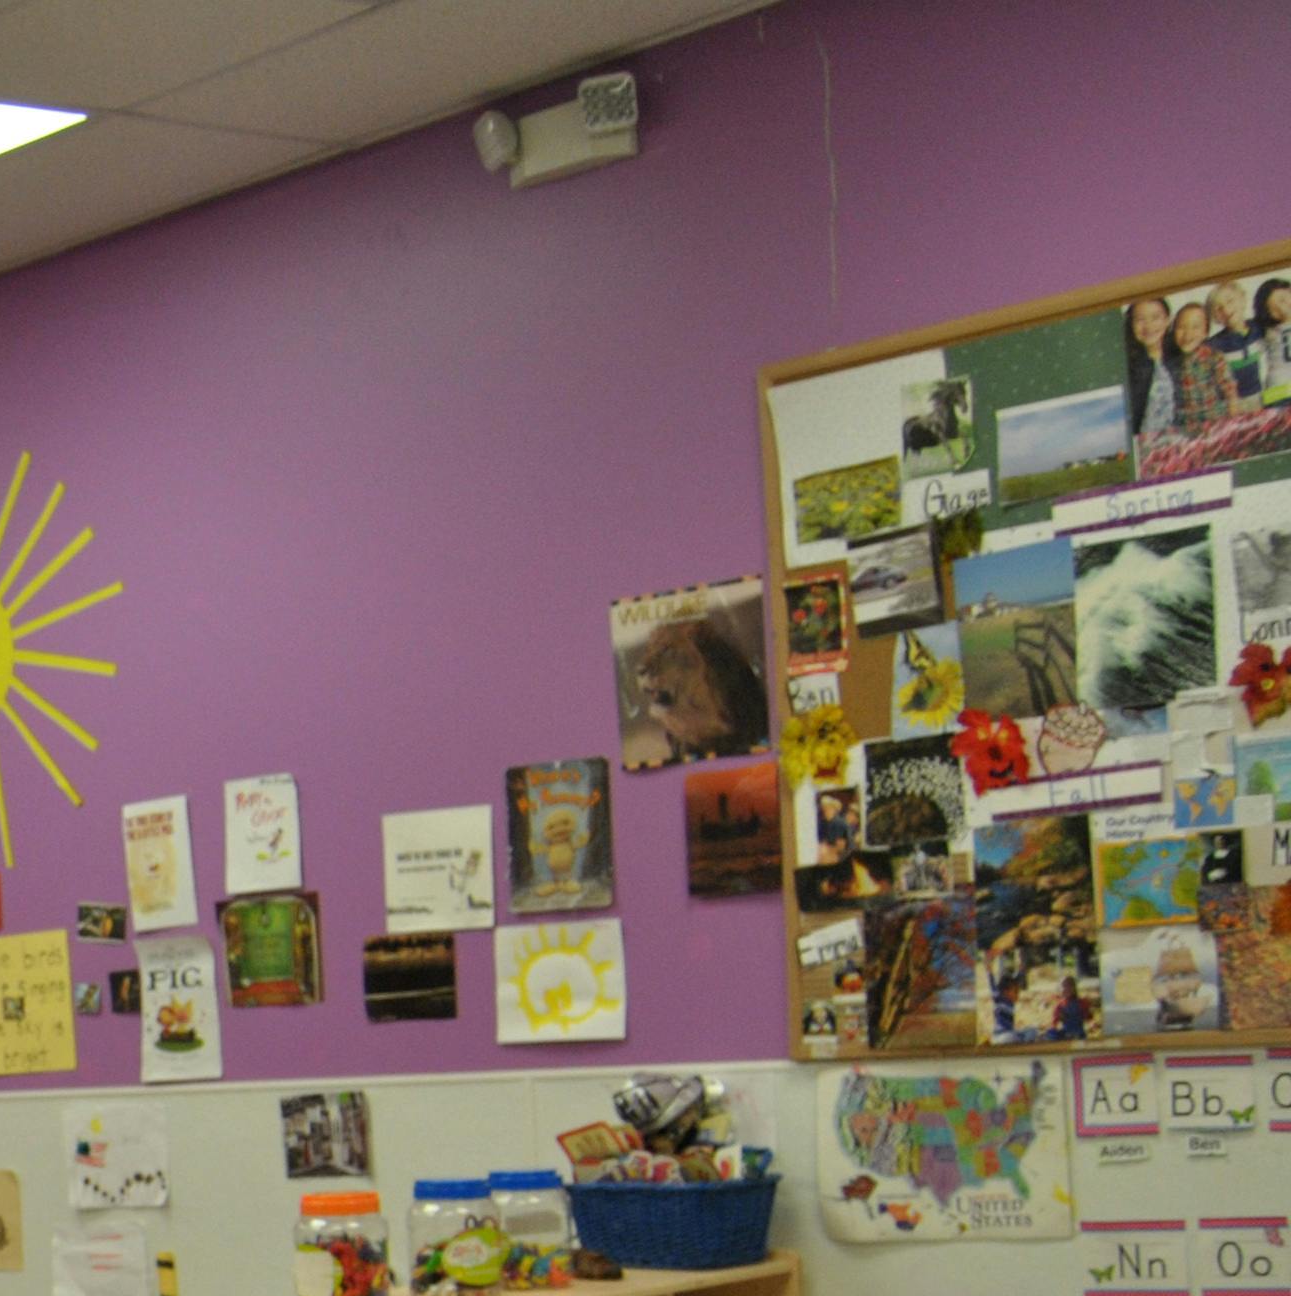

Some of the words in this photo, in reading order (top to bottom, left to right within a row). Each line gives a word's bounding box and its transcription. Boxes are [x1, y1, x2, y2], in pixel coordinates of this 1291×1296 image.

[1091, 1080, 1139, 1114] Aa
[1171, 1080, 1224, 1117] Bb
[955, 1196, 1025, 1215] UNITED
[970, 1211, 1032, 1229] STATES
[1118, 1243, 1168, 1279] Nn
[1217, 1241, 1273, 1278] Oo
